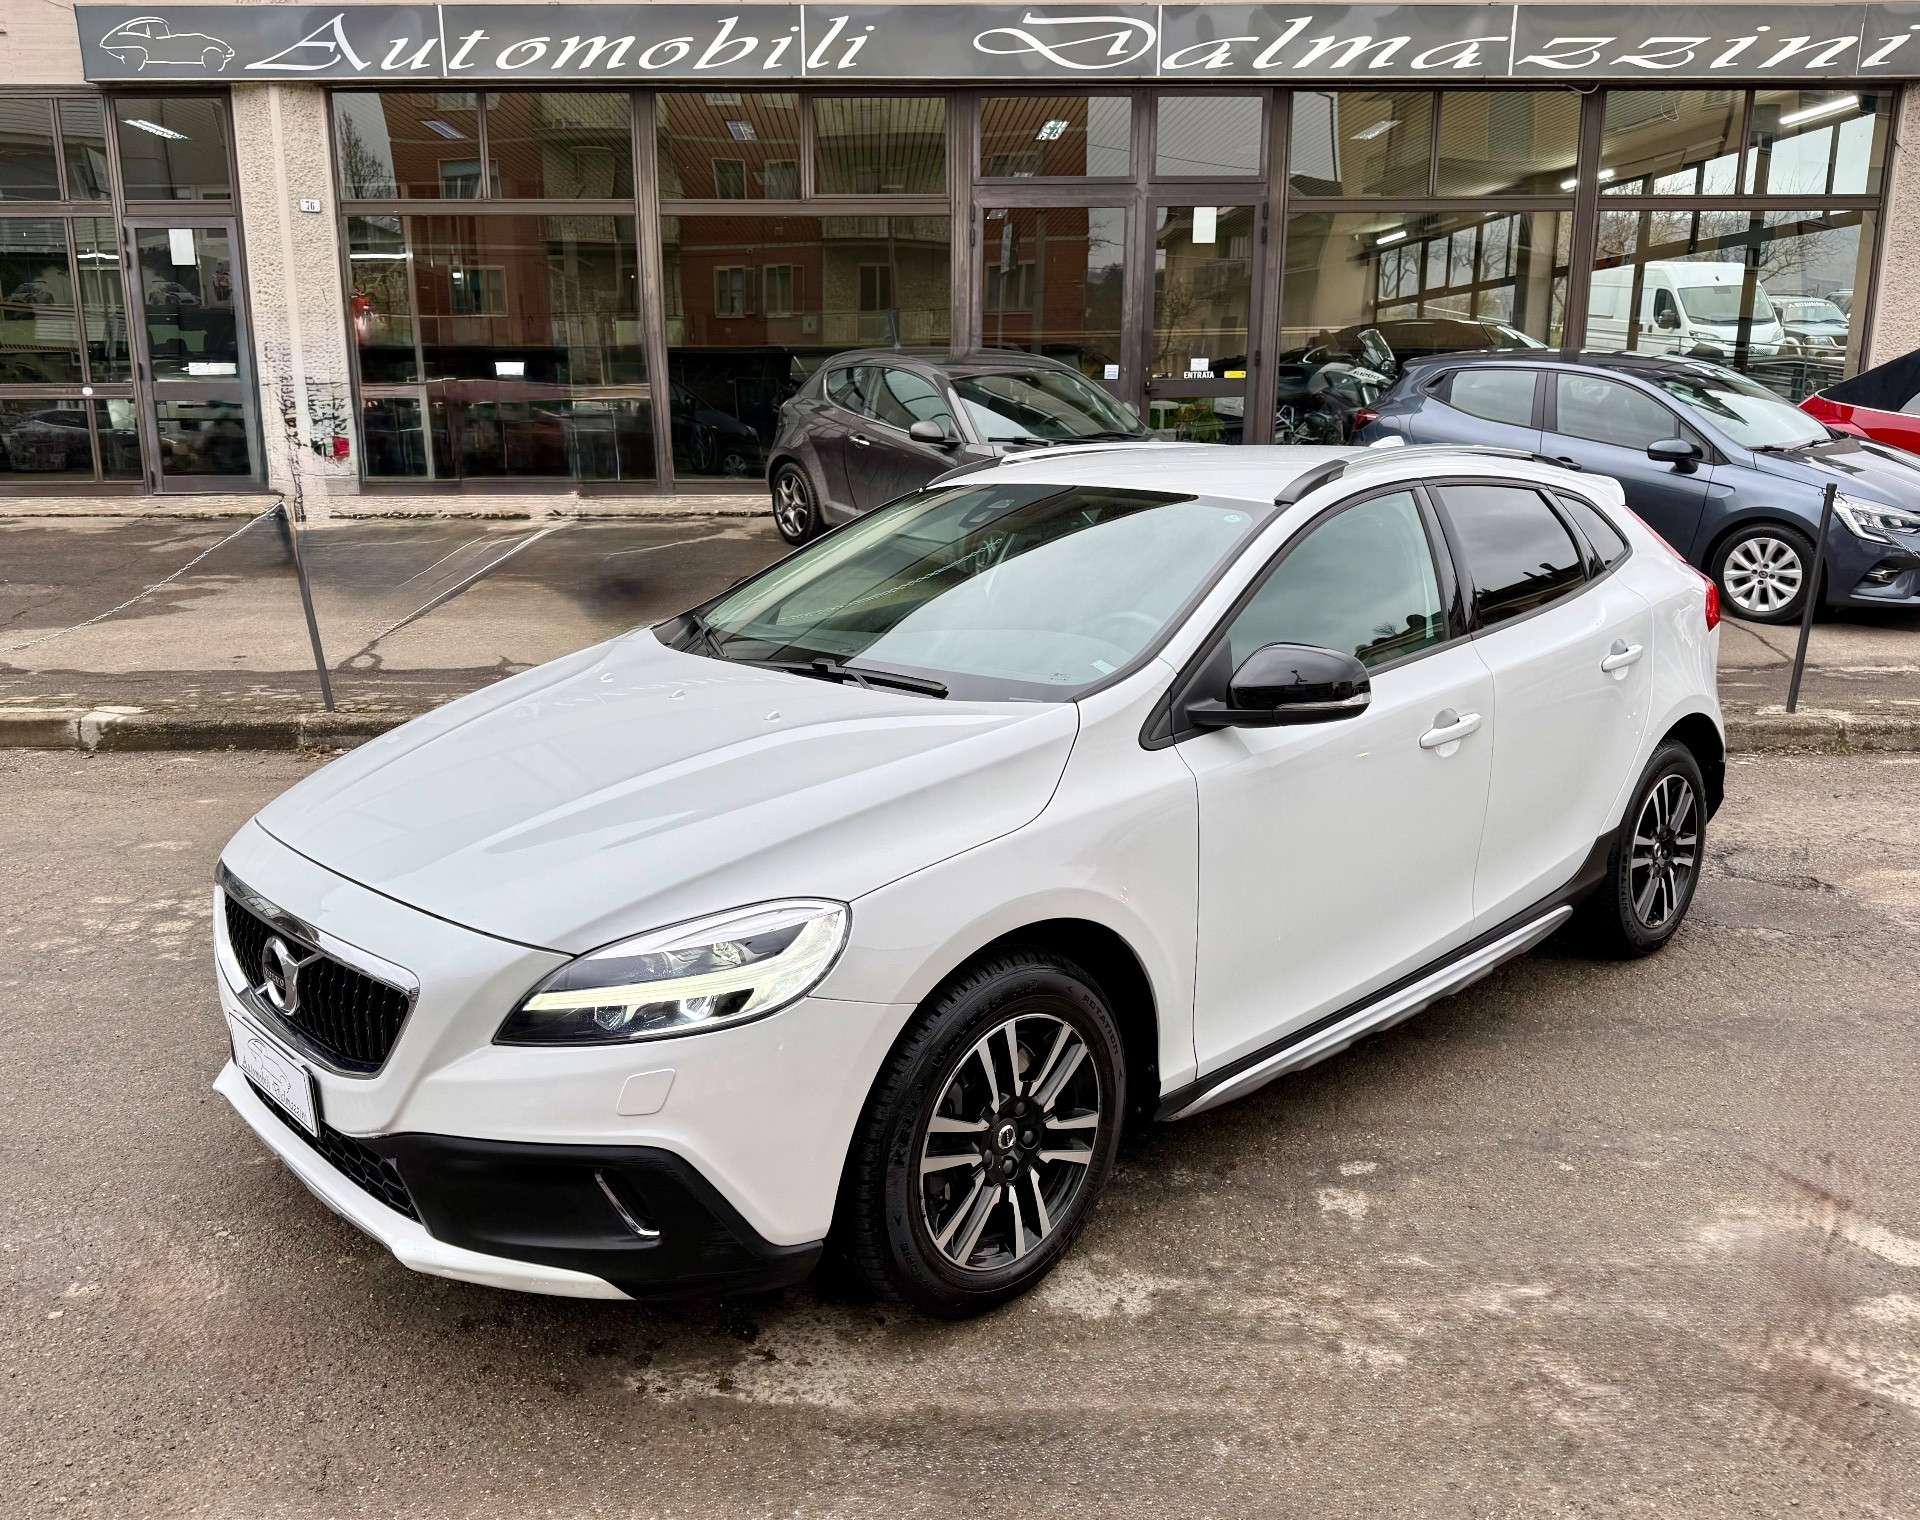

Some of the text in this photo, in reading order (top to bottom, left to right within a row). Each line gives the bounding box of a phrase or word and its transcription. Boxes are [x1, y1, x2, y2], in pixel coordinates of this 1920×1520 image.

[244, 12, 1920, 72] Automobili Dalmazzini
[305, 200, 315, 210] 76
[1183, 371, 1215, 379] ENTRATA
